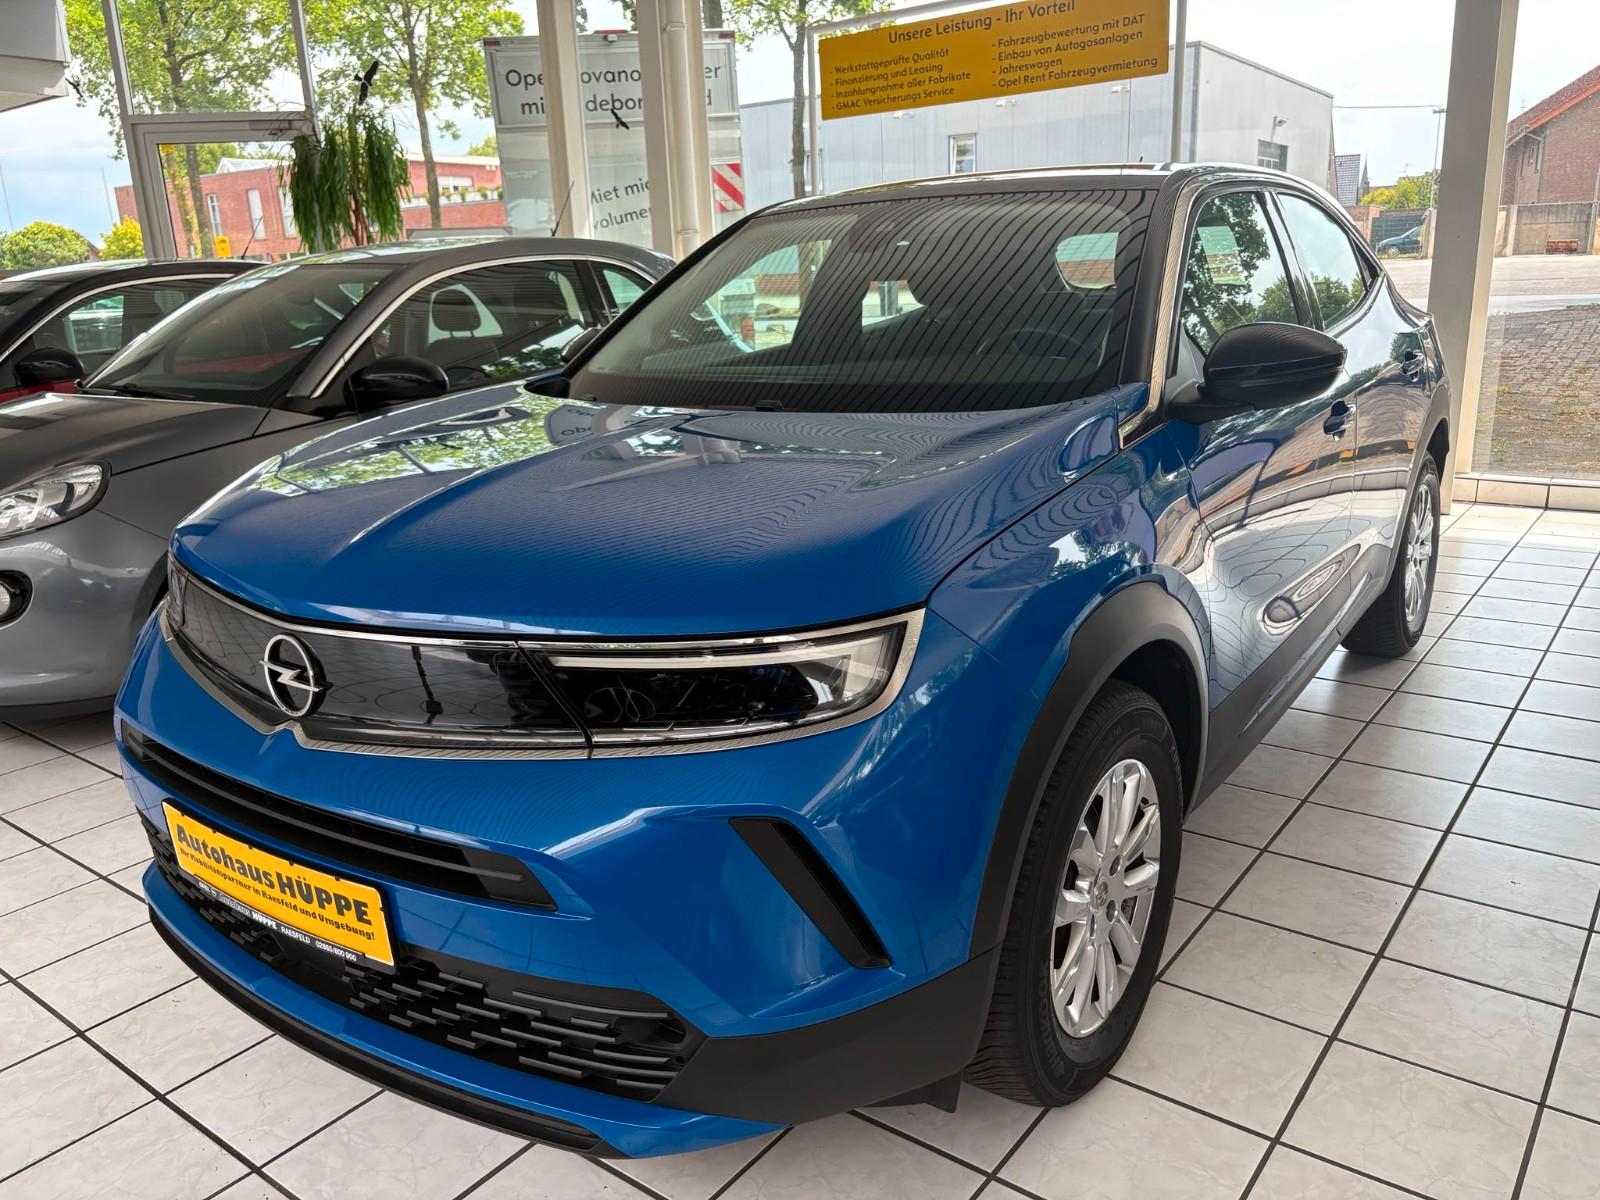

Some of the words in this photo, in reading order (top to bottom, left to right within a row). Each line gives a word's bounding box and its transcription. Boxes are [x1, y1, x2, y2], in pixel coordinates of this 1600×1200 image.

[888, 27, 932, 44] Unsere
[936, 16, 992, 35] Leistung
[1005, 9, 1024, 23] Ihr
[1028, 0, 1075, 18] Vorteil
[998, 23, 1100, 48] Fahrzeugbewertung
[1102, 17, 1120, 31] mit
[1122, 14, 1145, 27] DAT
[998, 49, 1032, 61] Einbau
[1034, 46, 1052, 56] von
[1054, 31, 1143, 52] Autogasanlagen
[834, 55, 910, 74] Werkstattgeprüfte
[912, 48, 949, 63] Qualität
[998, 58, 1063, 75] Jahreswagen
[998, 75, 1021, 89] Opel
[1023, 73, 1046, 84] Rent
[1048, 57, 1158, 81] Fahrzeugvermietung
[505, 69, 544, 91] Ope
[580, 69, 642, 84] ovano
[835, 71, 889, 87] Finanzierung
[890, 66, 907, 78] und
[909, 62, 943, 76] Leasing
[835, 80, 905, 98] Inzahlungnahme
[906, 77, 926, 89] aller
[928, 71, 971, 86] Fabrikate
[521, 96, 545, 115] mi
[836, 98, 862, 111] GMAC
[863, 92, 921, 107] Versicherungs
[923, 86, 955, 98] Service
[276, 872, 373, 926] HÜPPE
[261, 890, 298, 912] Raesfeld
[299, 907, 317, 920] und
[318, 913, 376, 941] Umgebung!
[281, 926, 311, 944] RAESFELD
